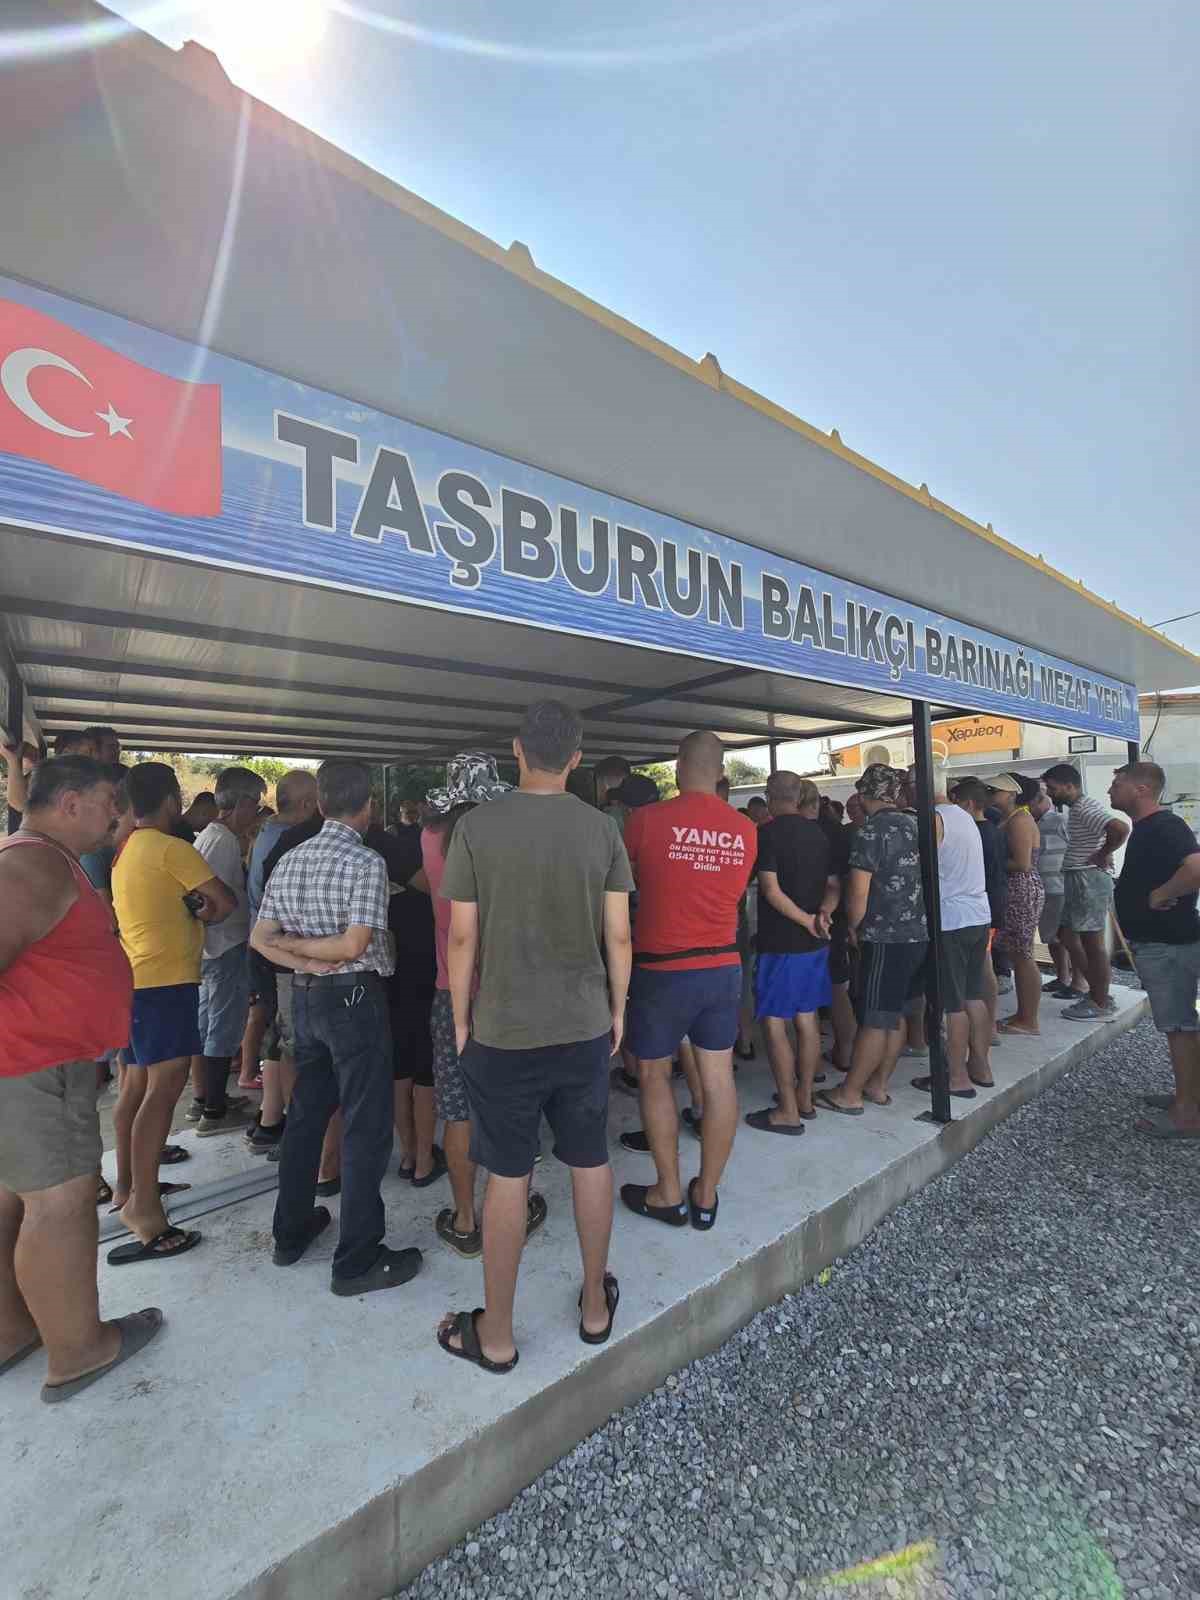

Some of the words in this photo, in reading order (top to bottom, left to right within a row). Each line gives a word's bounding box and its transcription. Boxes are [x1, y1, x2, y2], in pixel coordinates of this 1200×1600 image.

[272, 408, 746, 630] TAŞBURUN
[760, 570, 916, 681] BALIKÇI
[924, 624, 1035, 699] BARINAĞI
[1039, 664, 1091, 715] MEZAT
[671, 826, 745, 850] YANCA
[668, 851, 695, 861] 0542
[720, 856, 730, 865] 13
[693, 862, 721, 872] Didim
